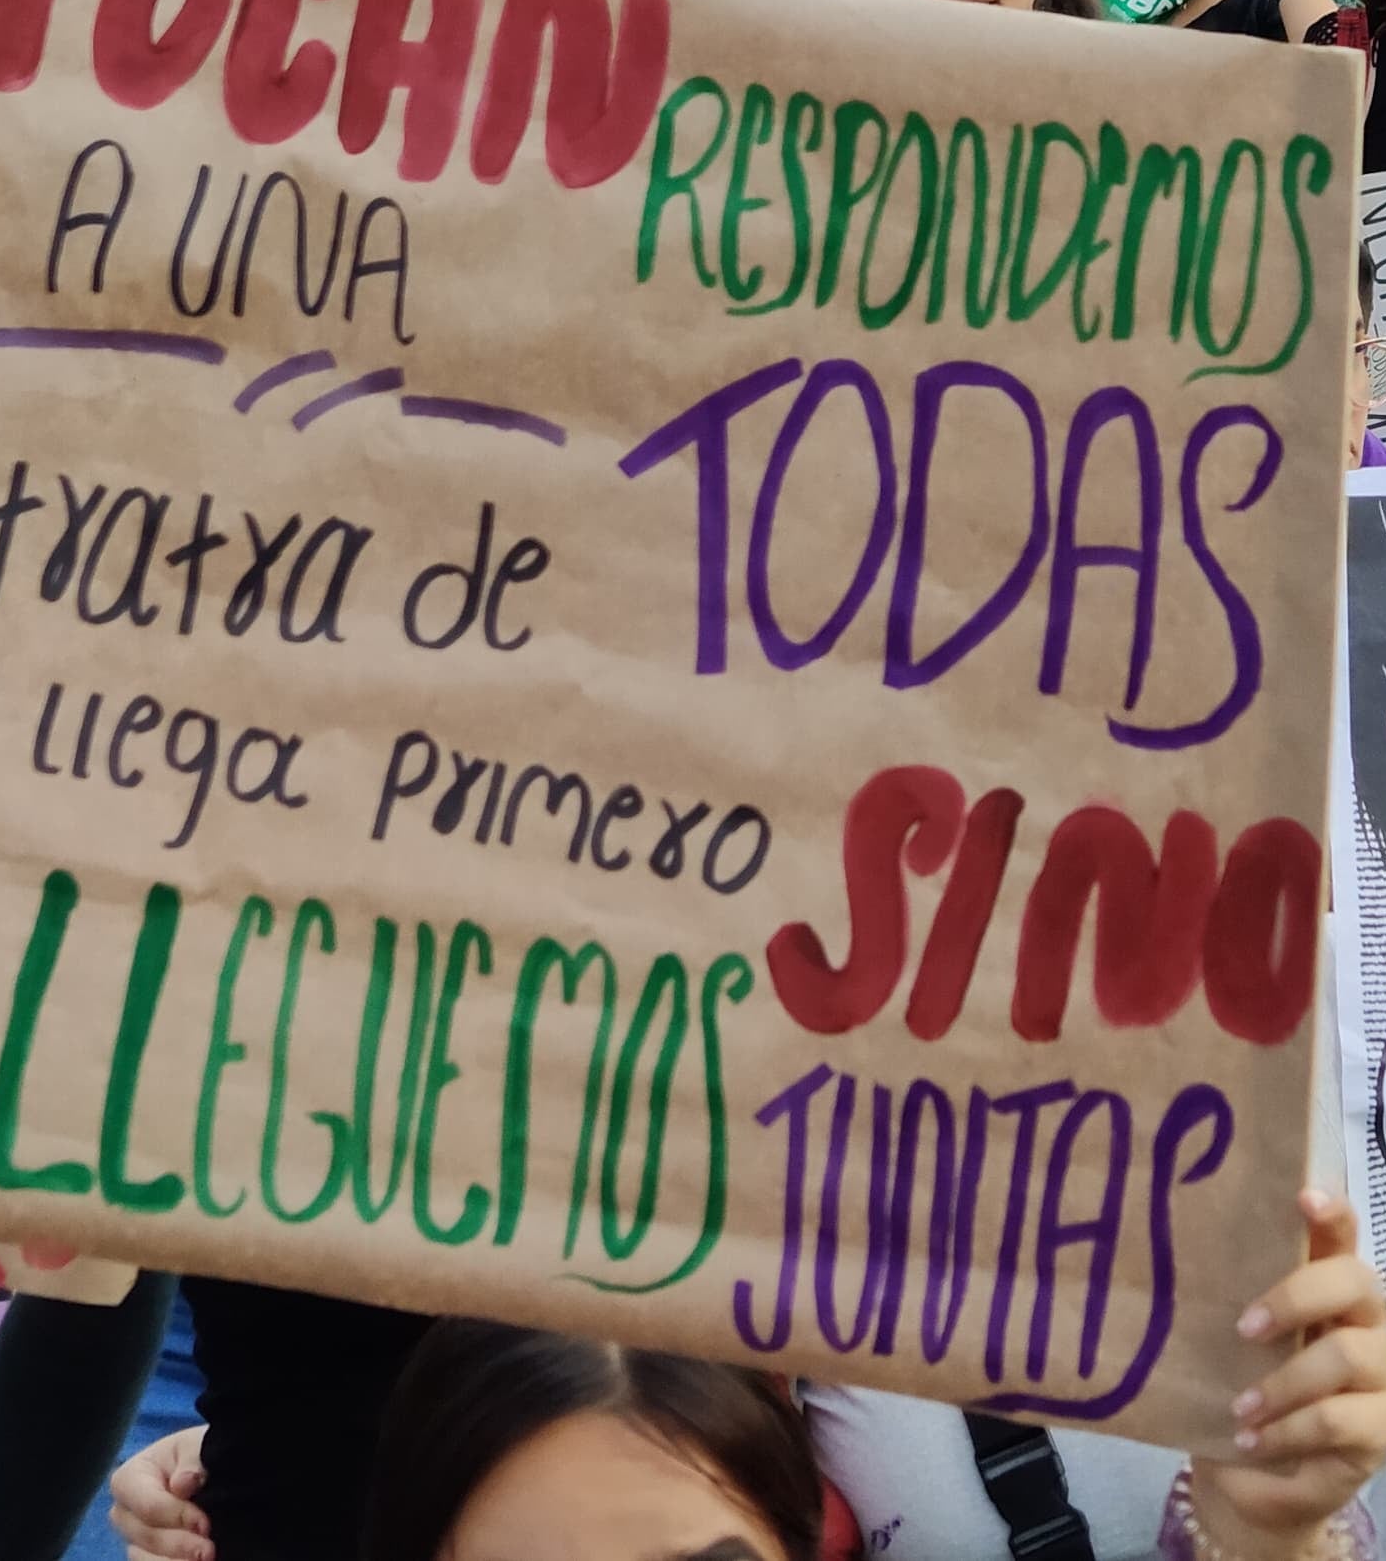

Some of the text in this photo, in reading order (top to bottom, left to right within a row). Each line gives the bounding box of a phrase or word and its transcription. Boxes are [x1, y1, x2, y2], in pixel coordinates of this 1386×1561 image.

[45, 72, 1336, 384] A UNA RESPONDEMOS
[403, 499, 554, 655] de
[616, 353, 1285, 749] TODAS
[764, 762, 1324, 1049] SINO
[730, 1059, 1240, 1423] JUNTAS
